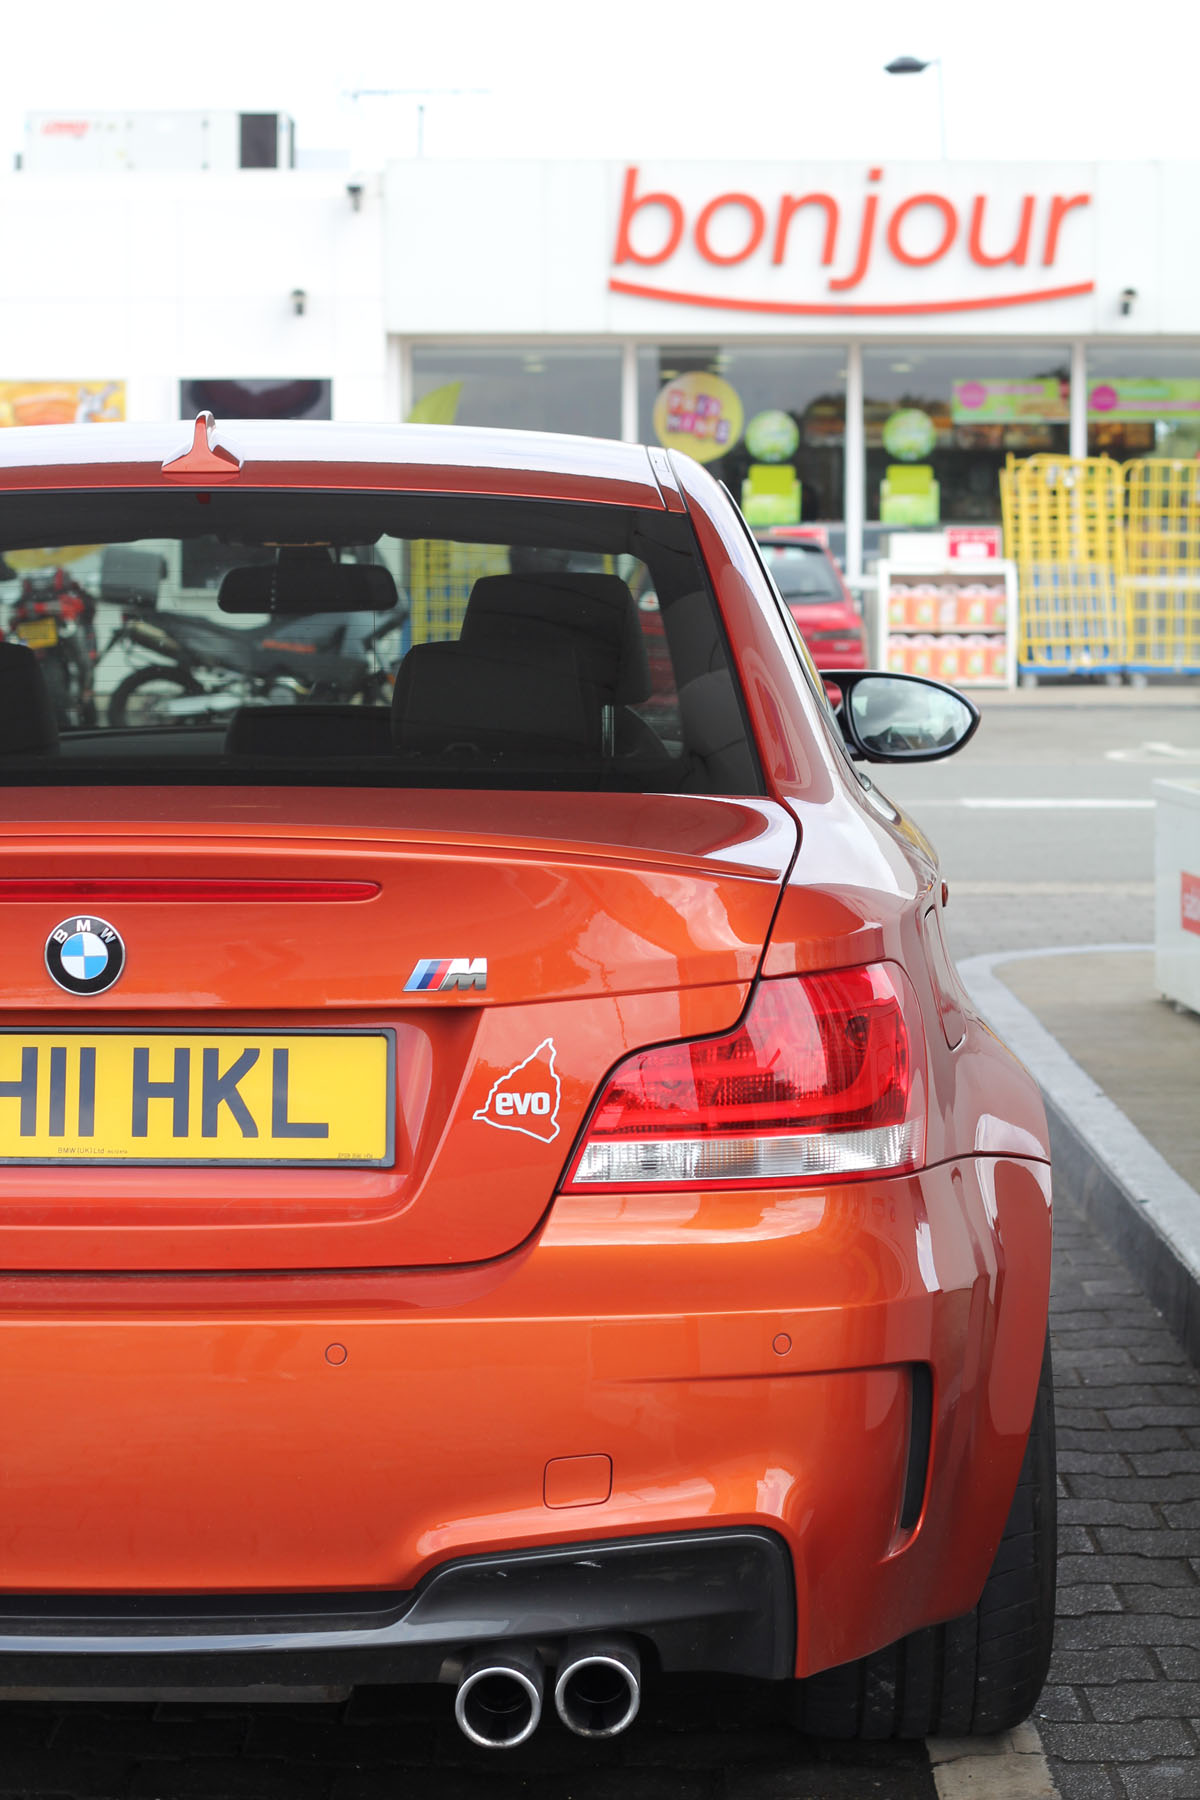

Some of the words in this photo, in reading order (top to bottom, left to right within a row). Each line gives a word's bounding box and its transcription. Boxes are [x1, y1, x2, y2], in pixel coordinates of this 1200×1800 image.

[612, 165, 1091, 292] bonjour
[53, 919, 117, 944] BMW
[131, 1047, 329, 1139] HKL
[495, 1092, 550, 1115] evo
